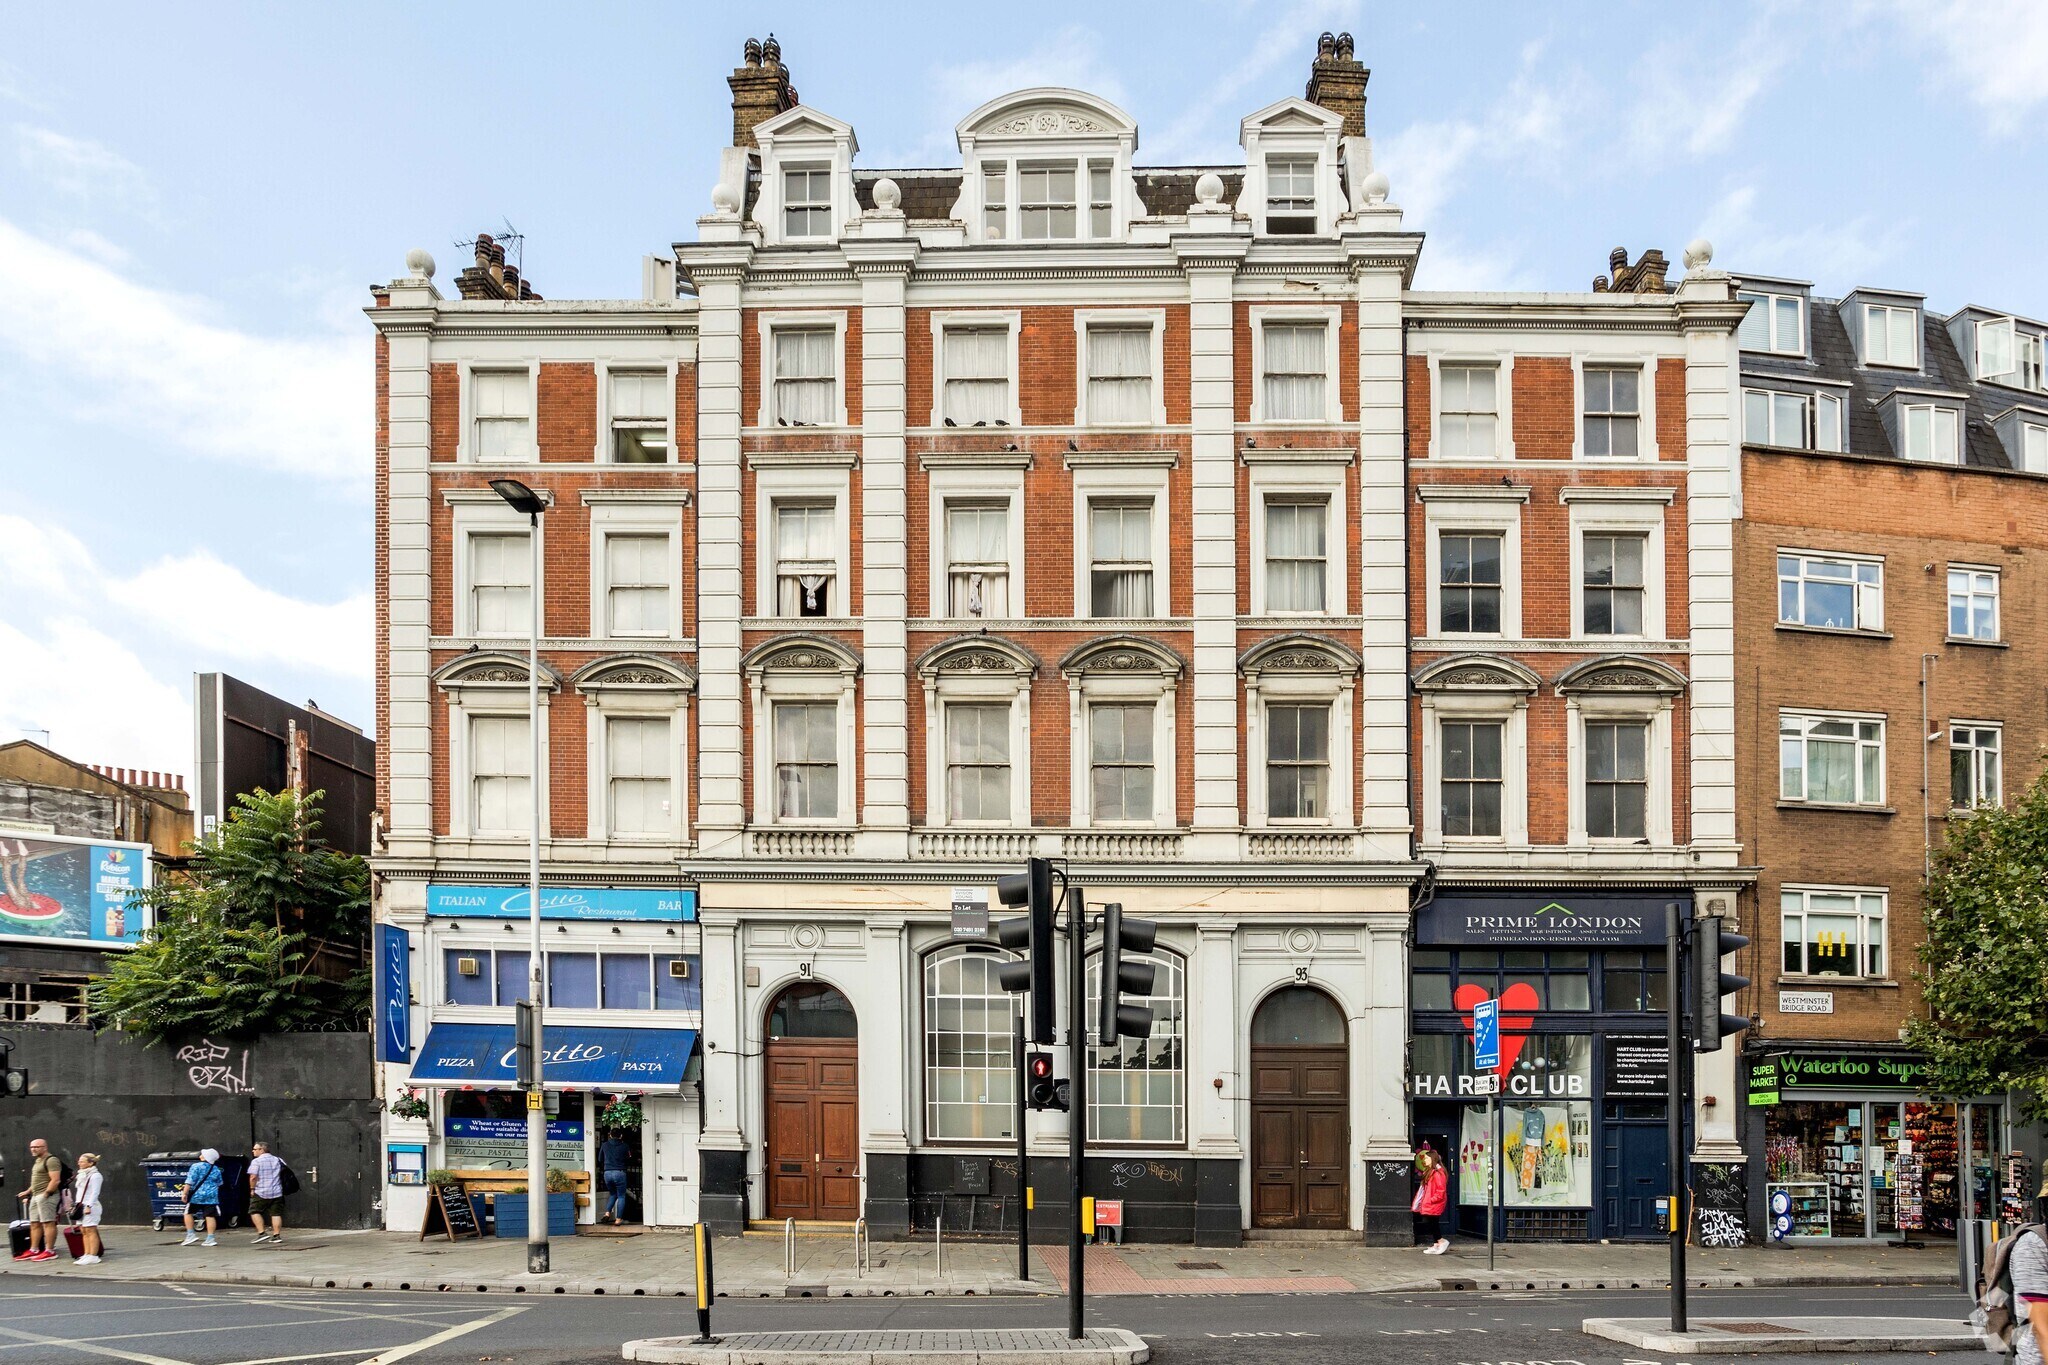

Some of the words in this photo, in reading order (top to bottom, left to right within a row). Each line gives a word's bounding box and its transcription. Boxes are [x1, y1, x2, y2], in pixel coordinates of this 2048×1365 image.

[439, 895, 487, 906] ITALIAN
[657, 899, 682, 910] BAR
[573, 904, 637, 916] Restaurant
[1466, 916, 1538, 928] PRIME
[1549, 916, 1642, 928] LONDON
[800, 962, 811, 977] 91
[1295, 967, 1308, 981] 93
[388, 937, 408, 1053] Cotto
[176, 1039, 230, 1063] RIP
[437, 1057, 475, 1067] PIZZA
[621, 1062, 662, 1071] PASTA
[1753, 1065, 1775, 1076] SUPER
[1780, 1056, 1870, 1075] Waterloo
[1415, 1075, 1476, 1095] HAR
[1511, 1074, 1583, 1095] CLUB
[1750, 1076, 1778, 1087] MARKET
[529, 1094, 542, 1108] H
[447, 1138, 463, 1146] Fully
[477, 1139, 516, 1147] Conditioned
[552, 1141, 584, 1149] Available
[454, 1148, 476, 1156] PIZZA
[487, 1149, 512, 1157] PASTA
[553, 1151, 575, 1159] GRILL
[1377, 1327, 1488, 1335] LEFT
